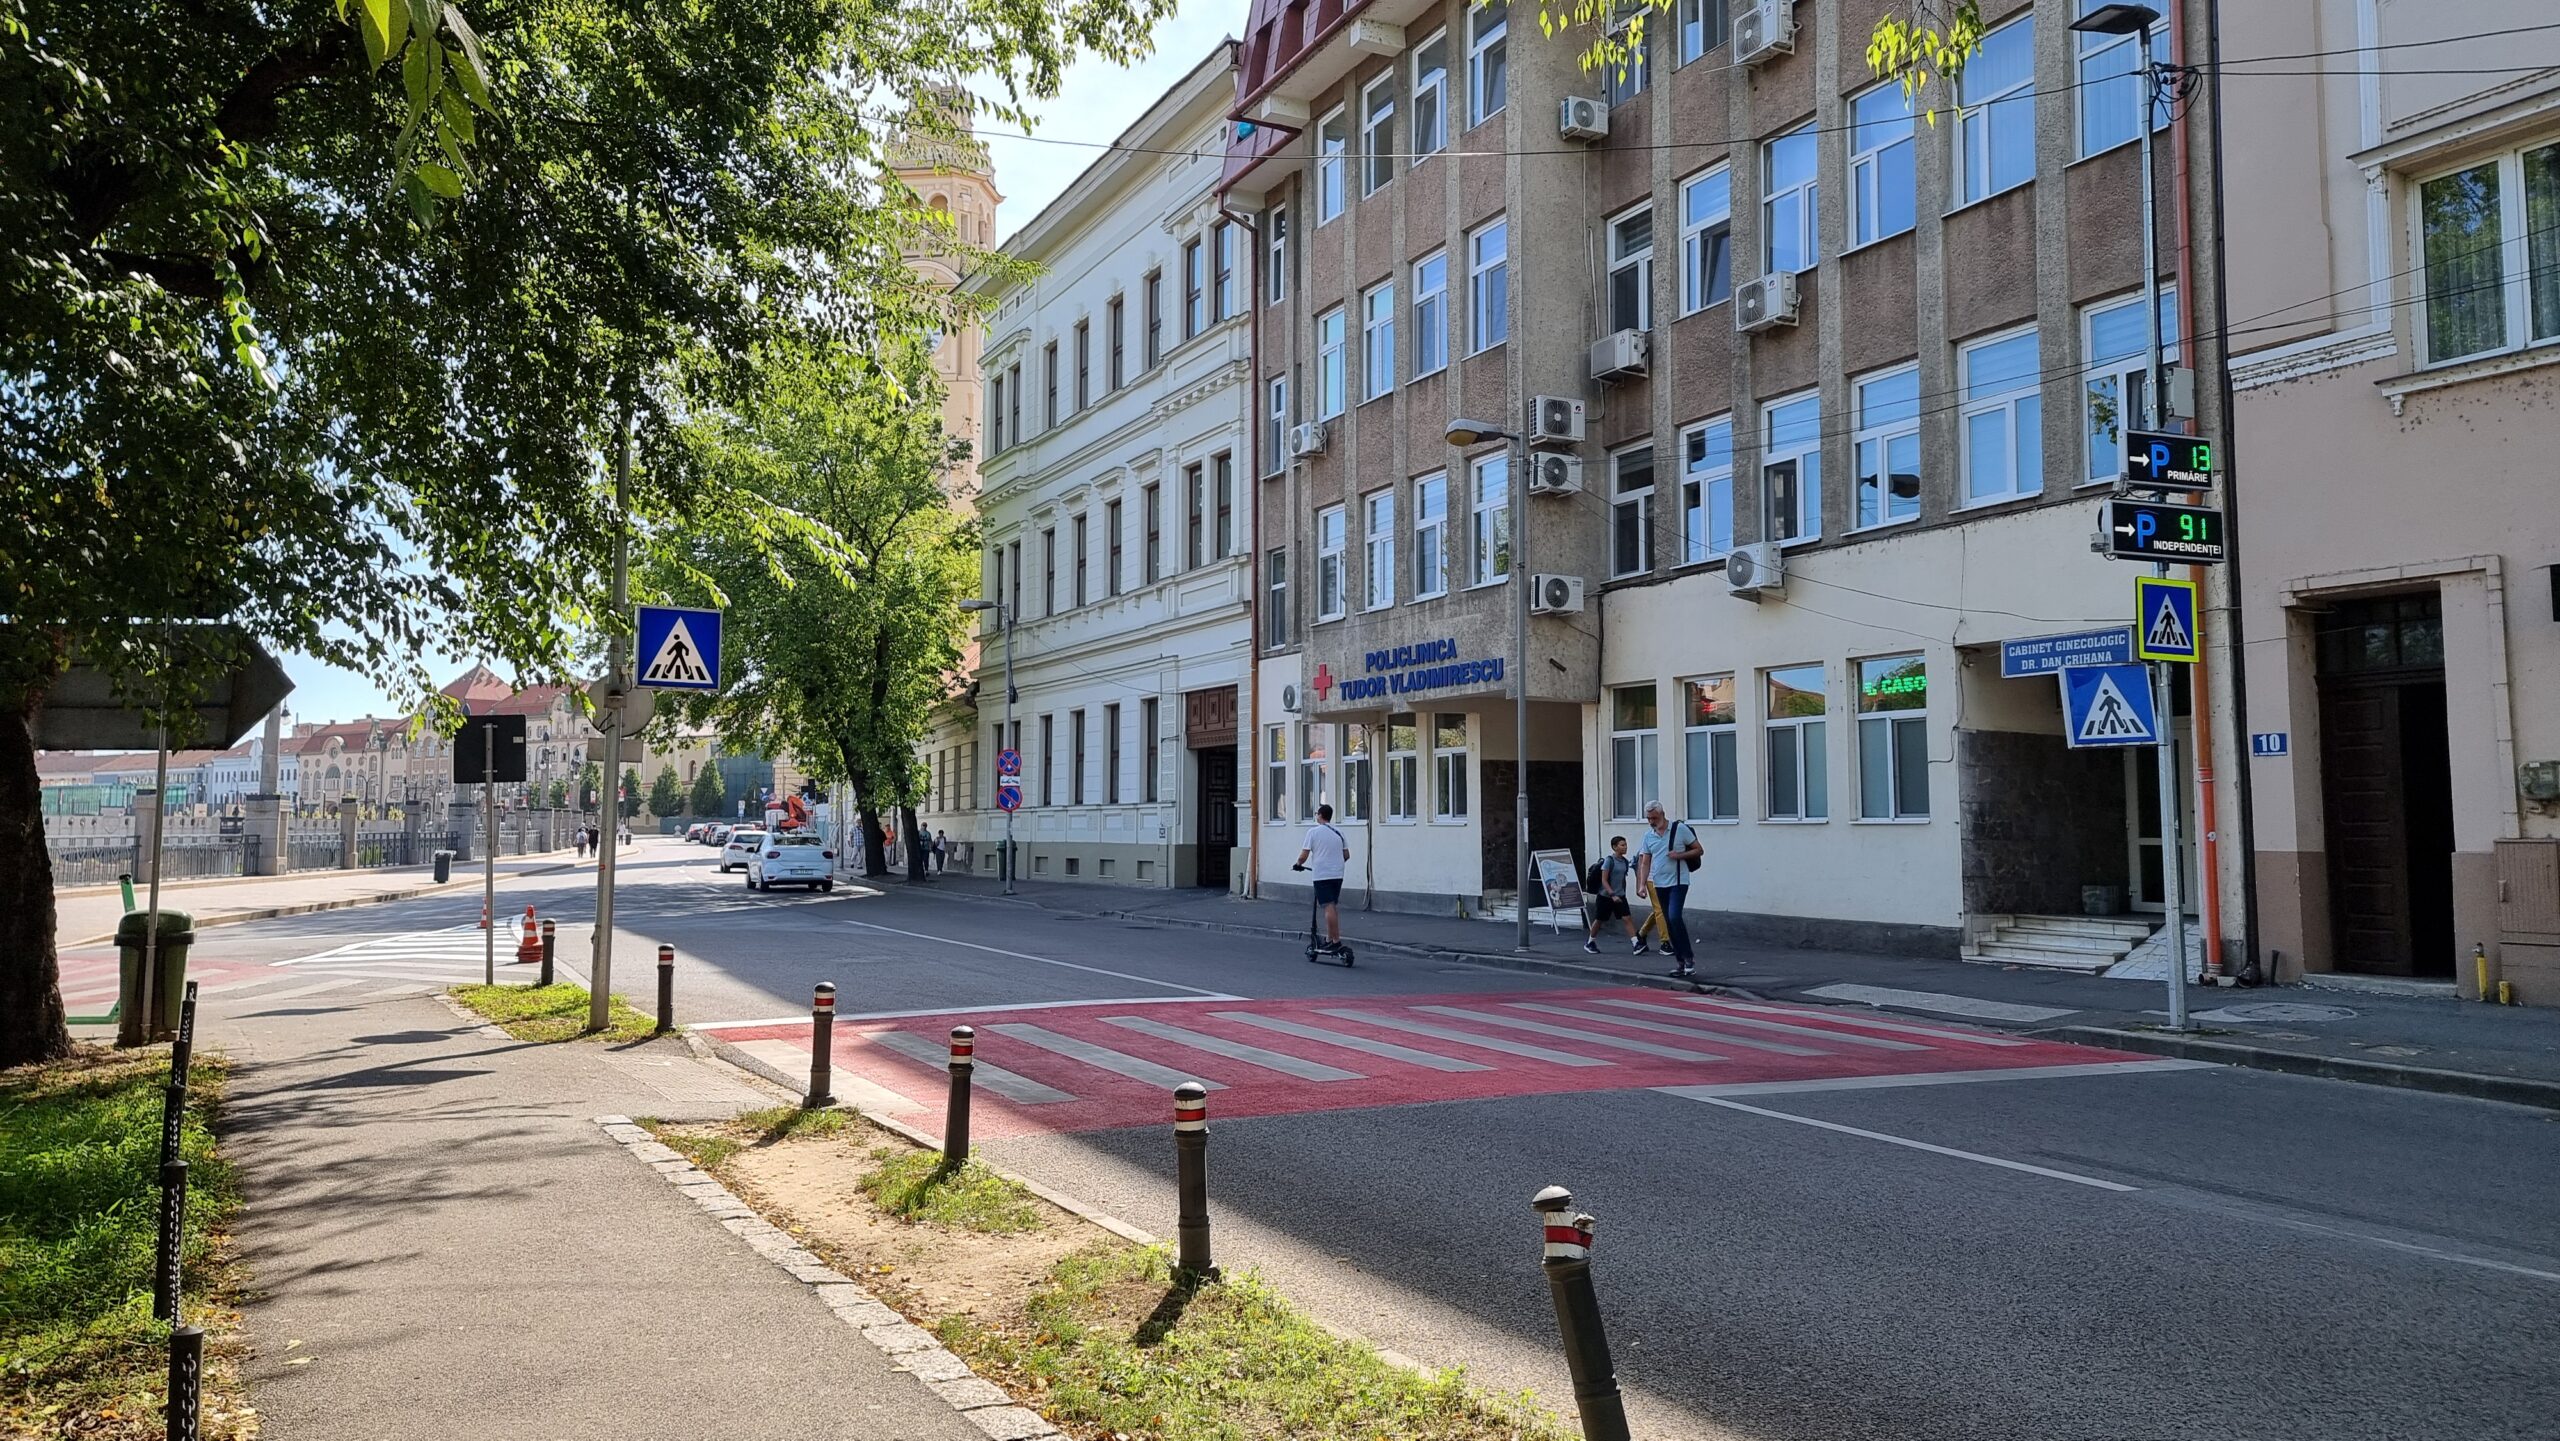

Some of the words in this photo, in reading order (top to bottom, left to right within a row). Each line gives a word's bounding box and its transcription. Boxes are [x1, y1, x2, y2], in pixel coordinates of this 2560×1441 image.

[2151, 444, 2170, 478] P
[2192, 445, 2211, 471] 13
[2167, 470, 2208, 483] PRIMĂRIE
[2137, 513, 2156, 548] P
[2180, 514, 2207, 540] 91
[2153, 540, 2222, 556] INDEPENDENȚEI
[1365, 637, 1458, 673] POLICLINICA
[2009, 642, 2053, 657] CABINET
[2055, 634, 2126, 652] GINECOLOGIC
[2021, 659, 2038, 670] DR.
[2041, 657, 2061, 668] DAN
[2065, 651, 2112, 666] CRIHANA
[1339, 676, 1387, 701] TUDOR
[1389, 657, 1505, 695] VLADIMIRESCU
[2259, 734, 2280, 752] 10
